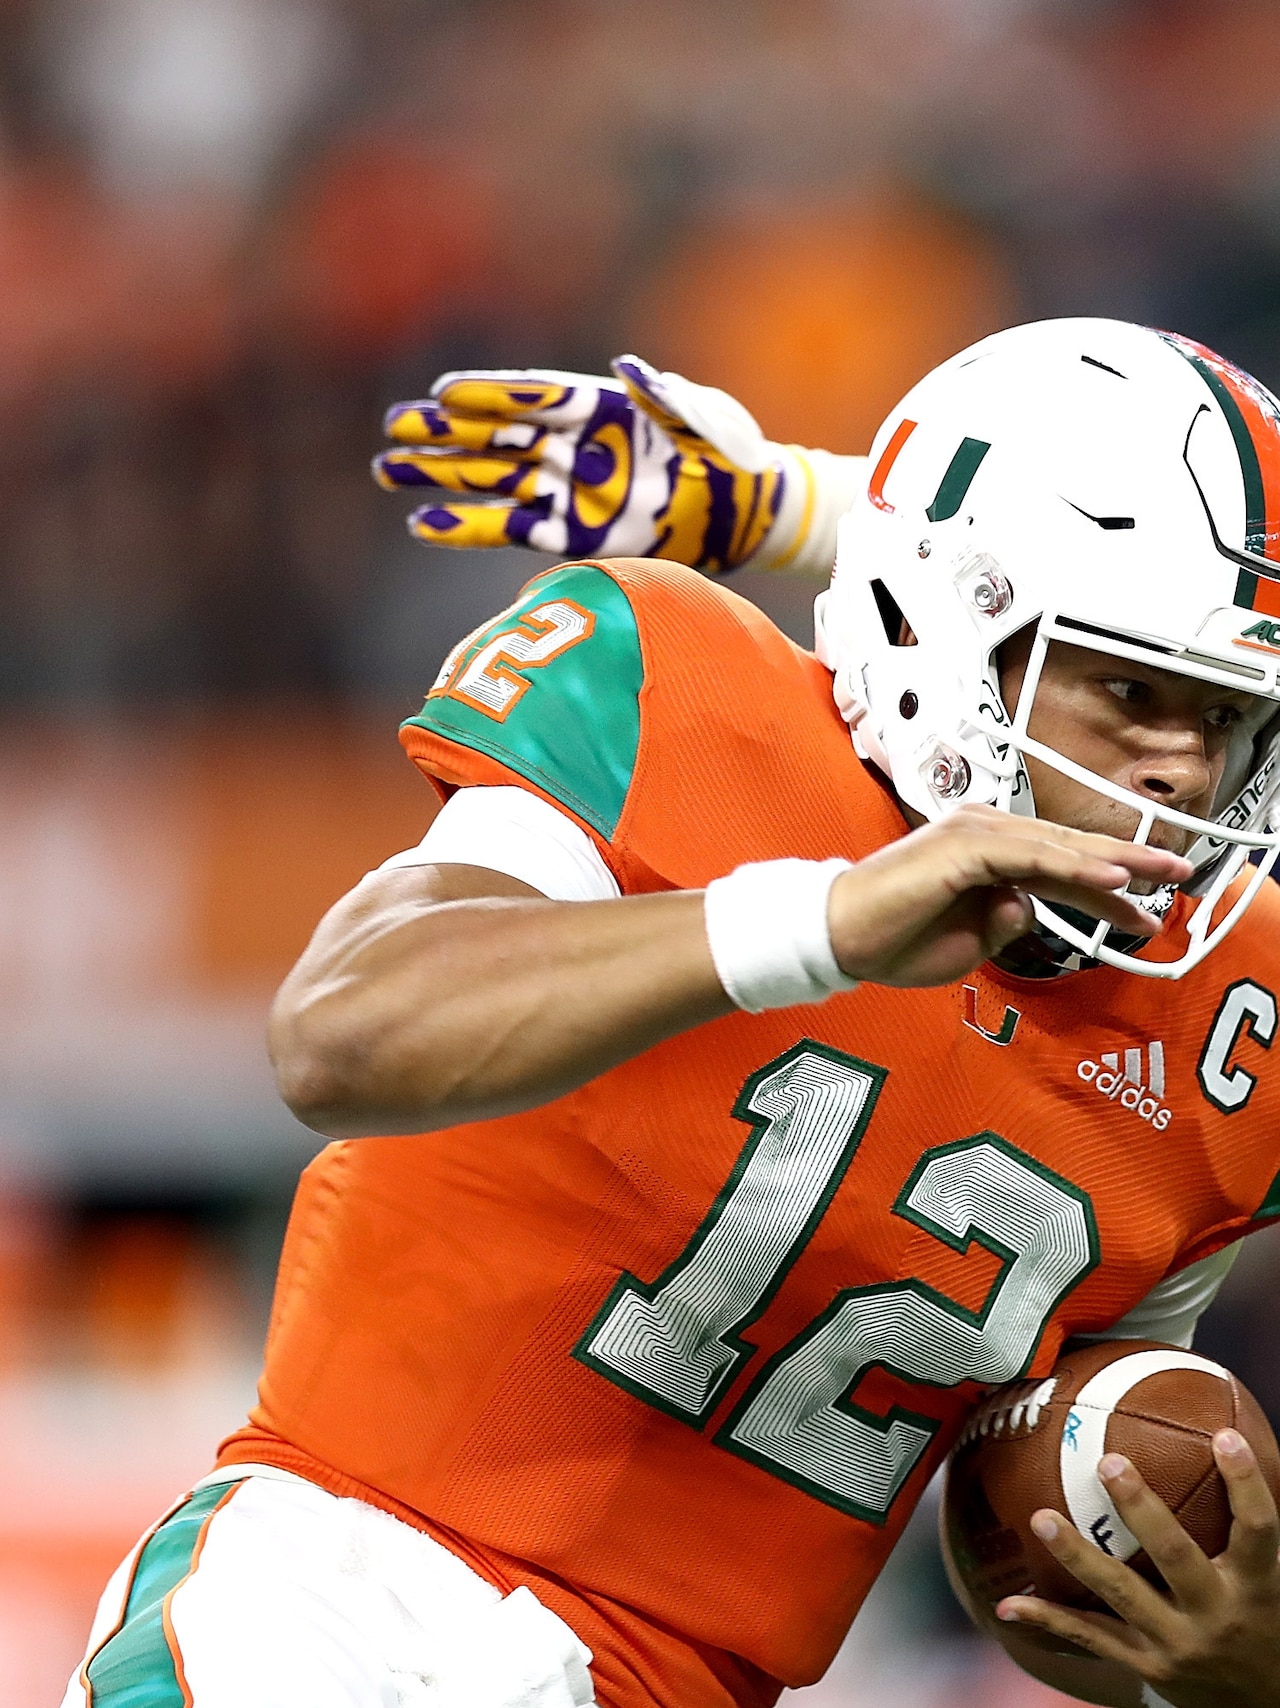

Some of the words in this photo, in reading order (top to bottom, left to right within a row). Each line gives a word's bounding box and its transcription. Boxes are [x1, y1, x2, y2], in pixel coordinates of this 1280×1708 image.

[867, 418, 992, 523] U
[1076, 1059, 1173, 1132] adidas
[1196, 976, 1280, 1117] C
[571, 1037, 1101, 1524] 12
